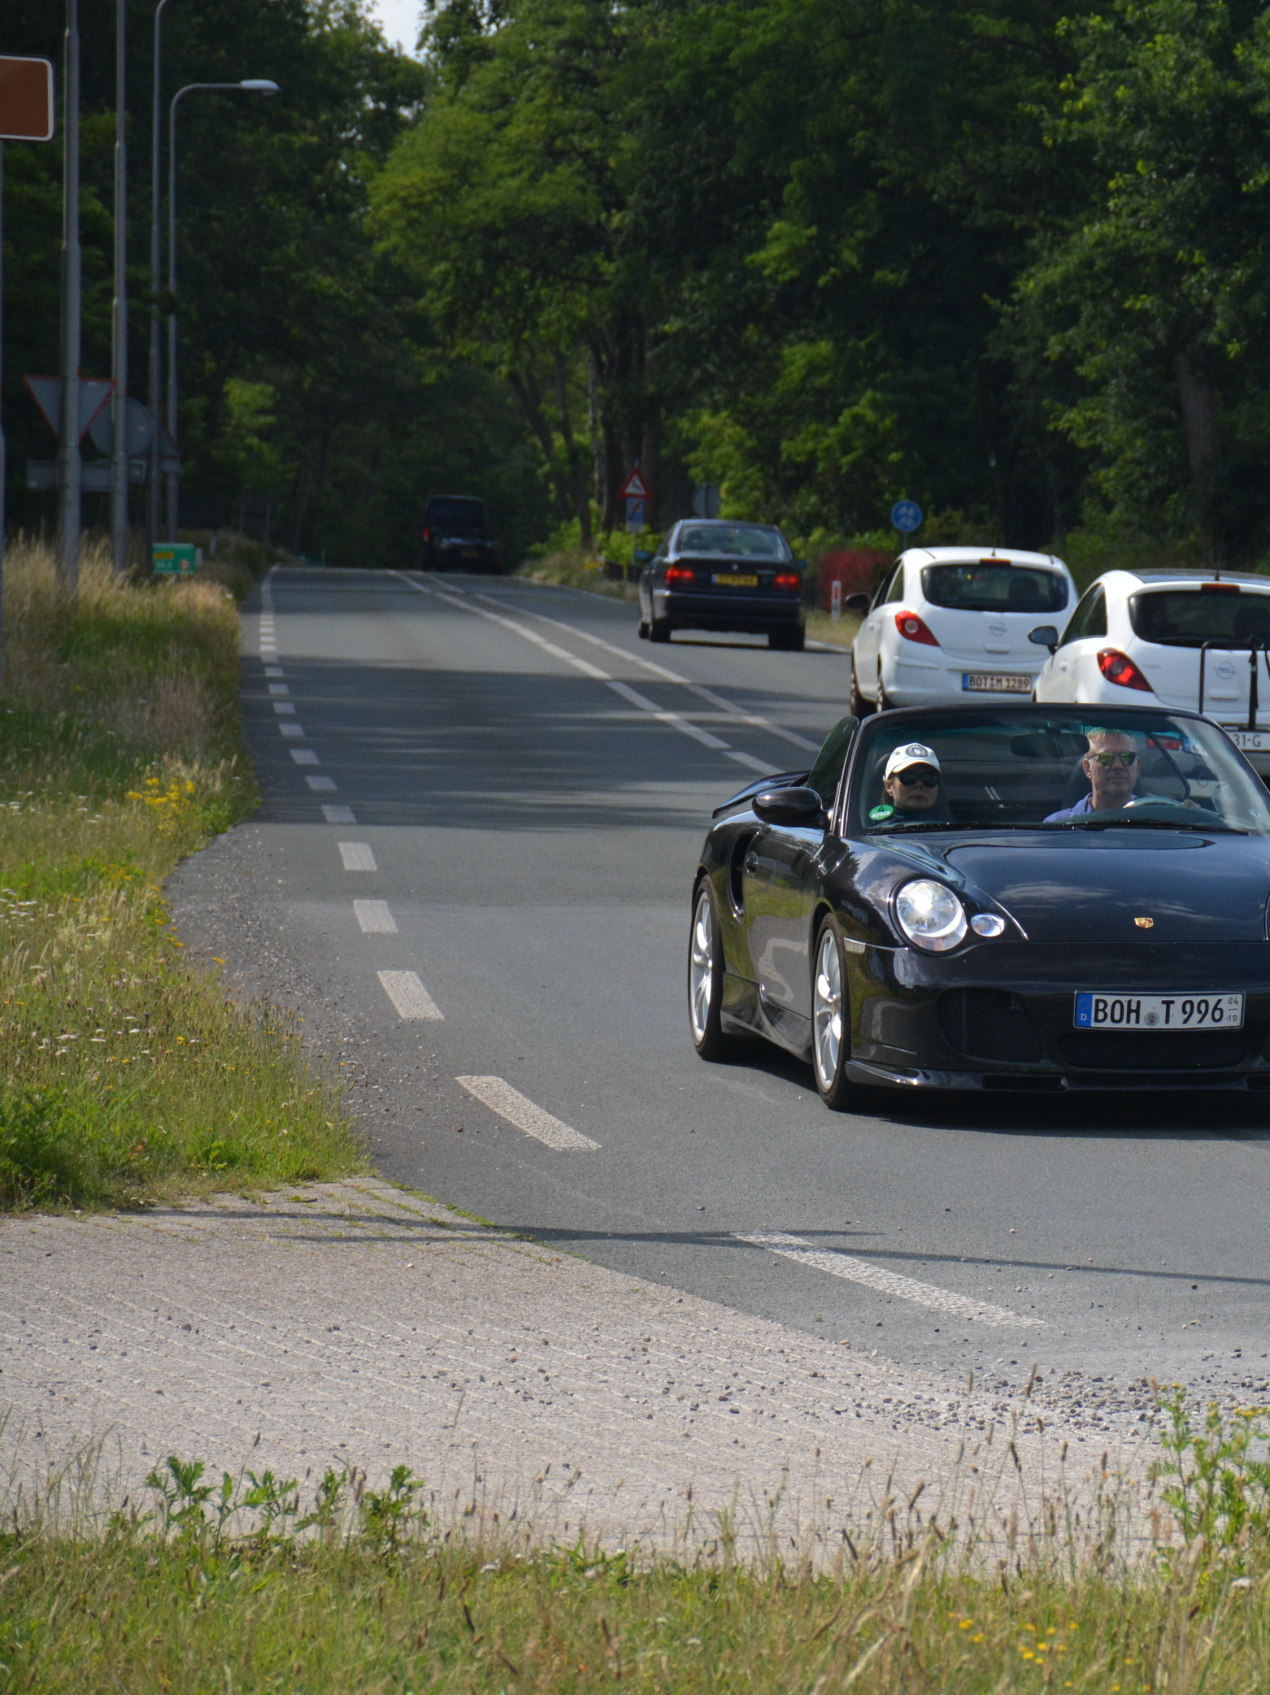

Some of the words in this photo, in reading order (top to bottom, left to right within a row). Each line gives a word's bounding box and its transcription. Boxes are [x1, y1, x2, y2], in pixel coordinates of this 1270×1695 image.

[1094, 999, 1142, 1024] BOH
[1161, 1000, 1175, 1024] T
[1181, 999, 1224, 1024] 996
